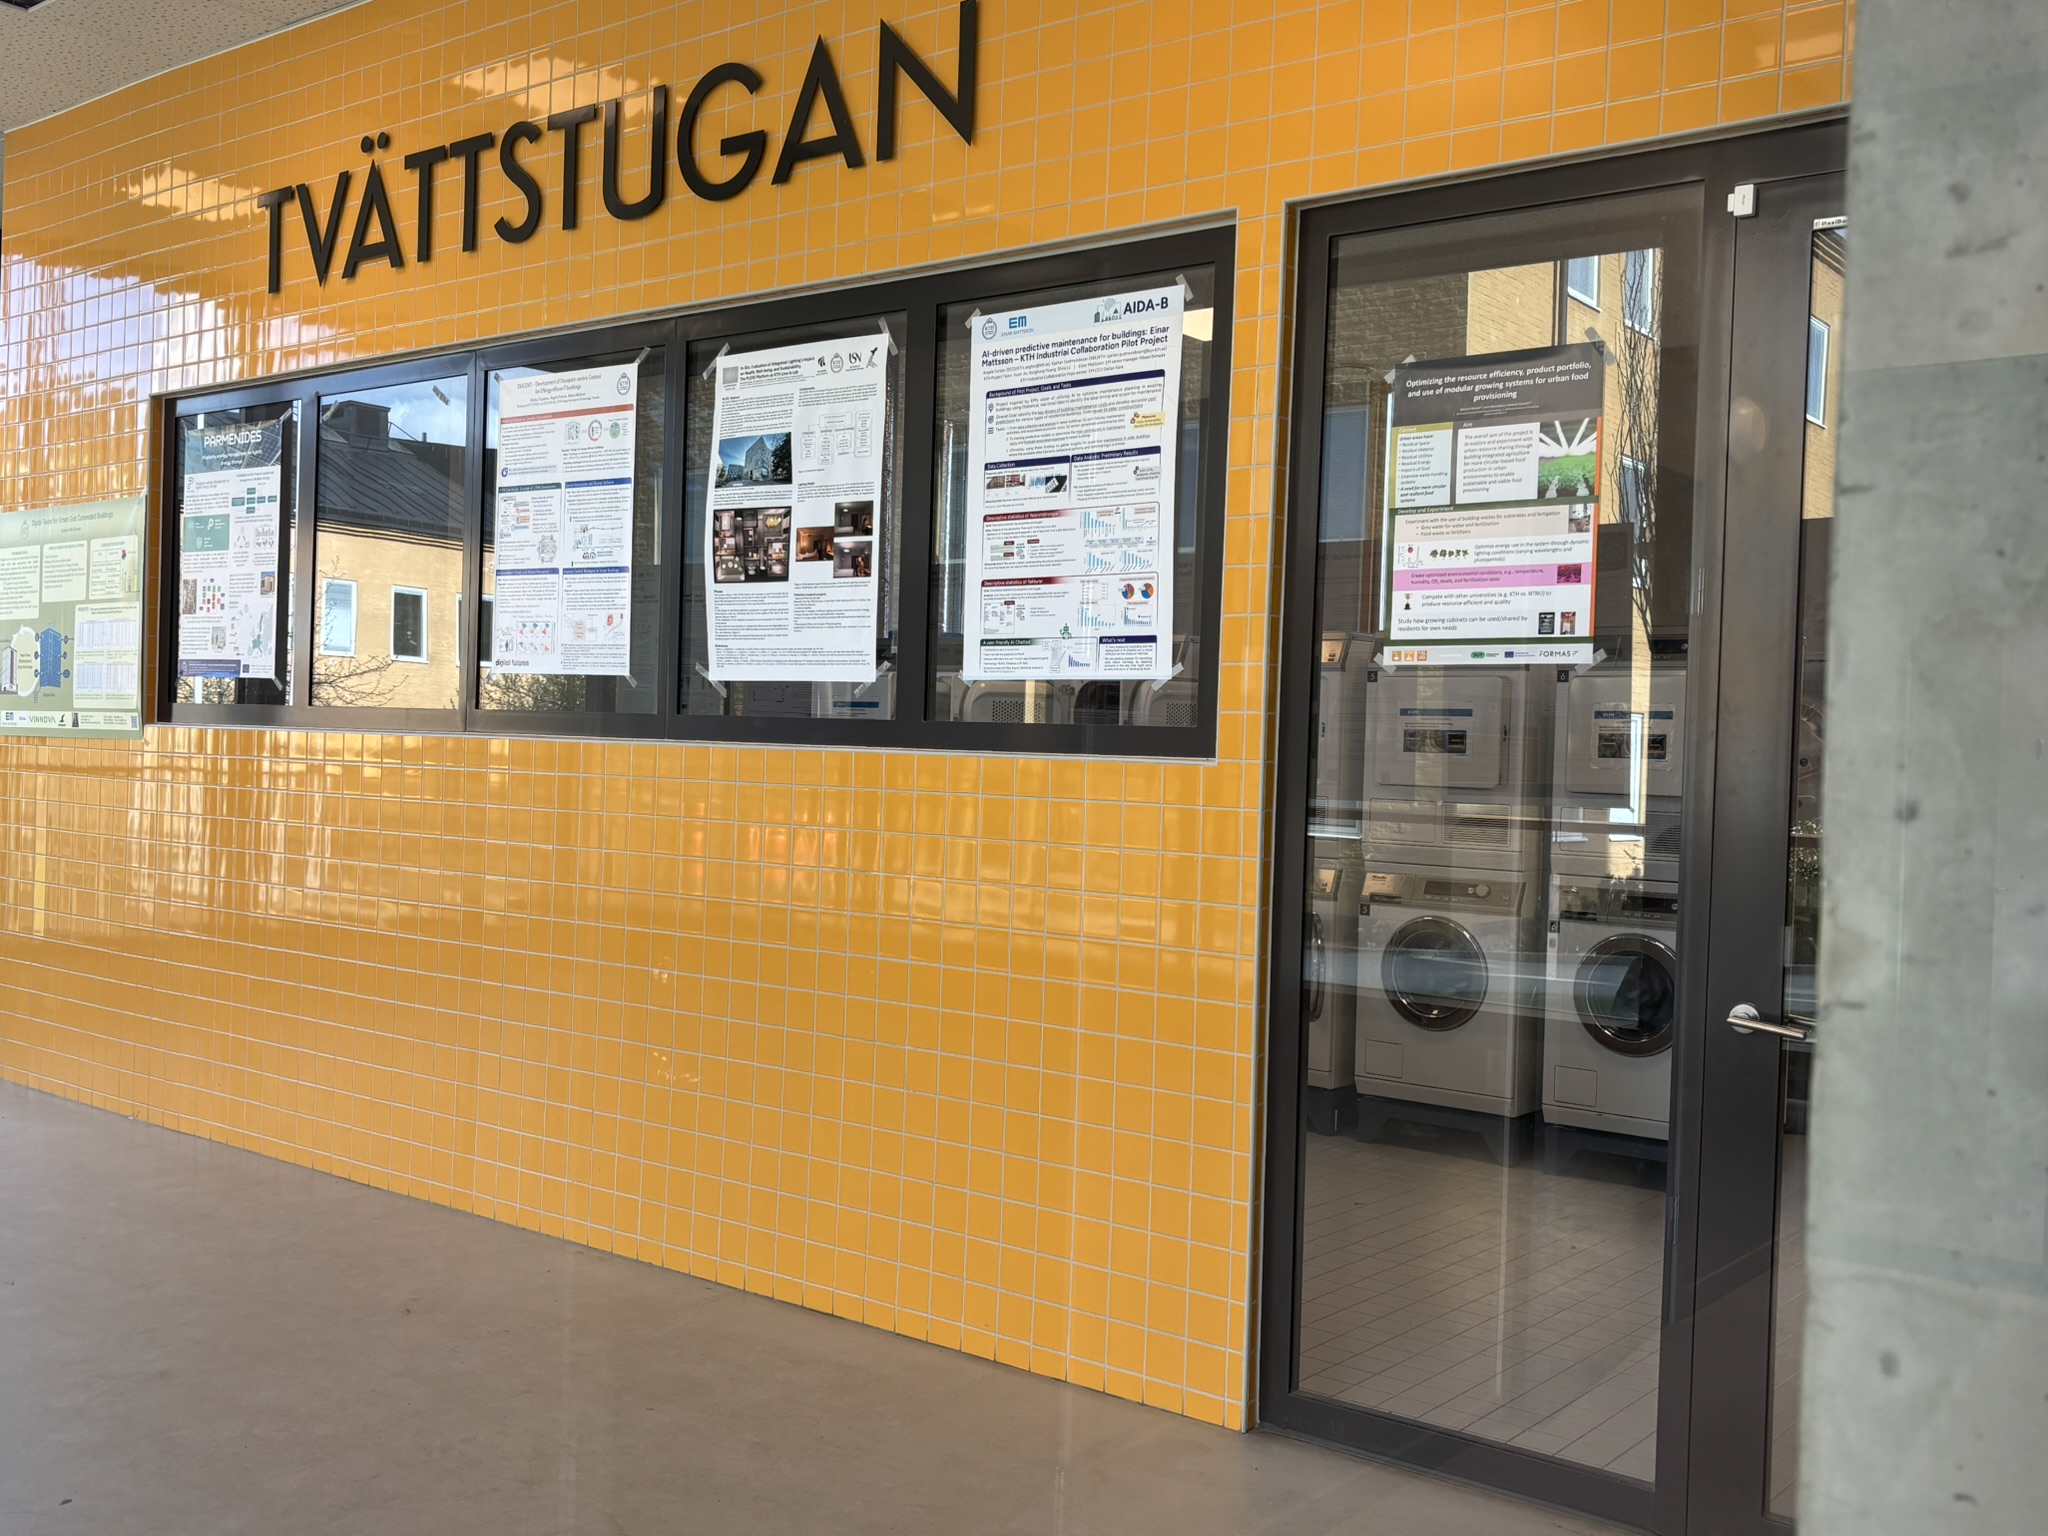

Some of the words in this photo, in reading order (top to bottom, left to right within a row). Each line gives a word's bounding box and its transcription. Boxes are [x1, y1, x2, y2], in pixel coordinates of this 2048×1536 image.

[257, 0, 978, 295] TVÄTTSTUGAN
[1123, 296, 1168, 314] AIDA-B
[1008, 315, 1026, 328] EM
[982, 348, 1013, 357] AI-driven
[1014, 342, 1049, 354] predictive
[1051, 336, 1097, 348] maintenance
[1111, 329, 1147, 340] buildings:
[1149, 326, 1169, 334] Einar
[982, 357, 1012, 366] Mattsson
[1020, 352, 1034, 361] KTH
[1036, 348, 1068, 359] Industrial
[1070, 342, 1119, 354] Collaboration
[1121, 338, 1138, 347] Pilot
[1140, 334, 1167, 345] Project
[1406, 377, 1442, 387] Optimizing
[1488, 369, 1524, 378] efficiency,
[1526, 365, 1554, 375] product
[1556, 361, 1591, 372] portfolio,
[1444, 384, 1473, 393] modular
[1474, 381, 1503, 391] growing
[1504, 378, 1533, 388] systems
[1571, 371, 1588, 380] food
[1473, 390, 1517, 402] provisioning
[203, 429, 262, 447] PARMENIDES
